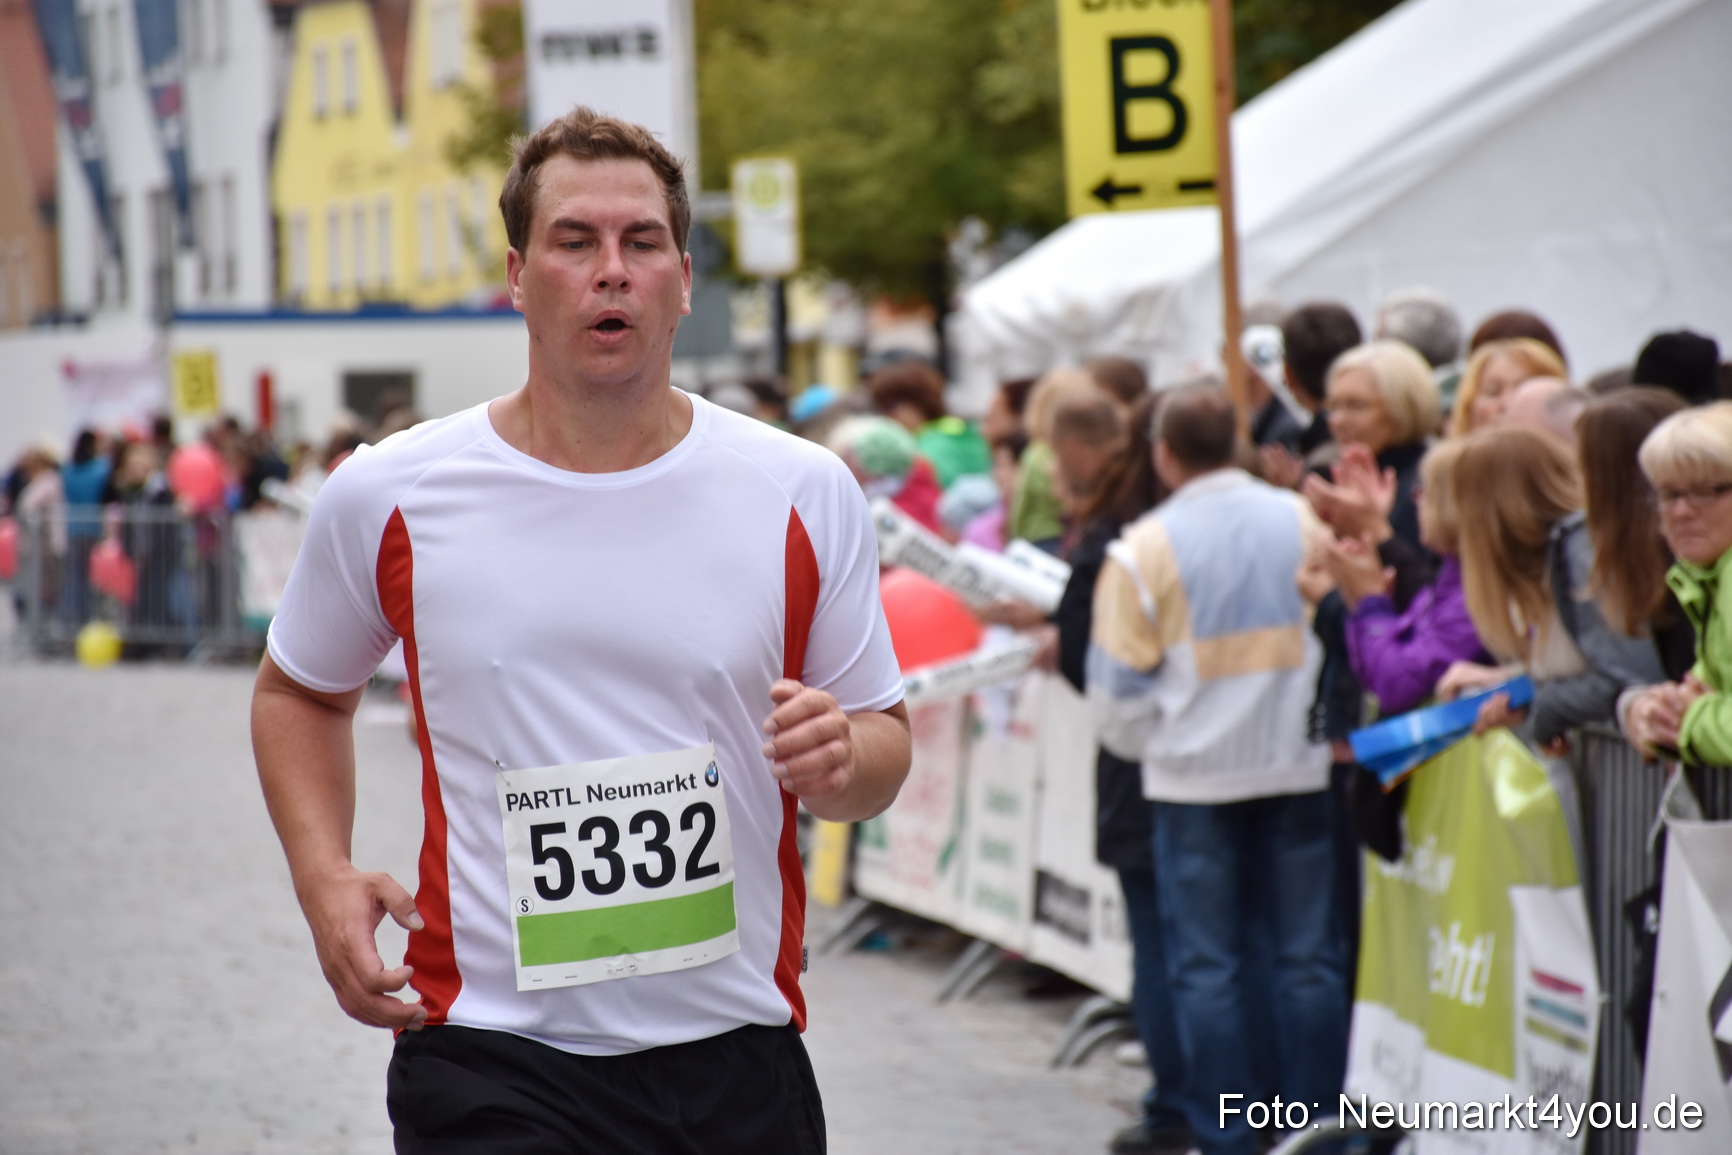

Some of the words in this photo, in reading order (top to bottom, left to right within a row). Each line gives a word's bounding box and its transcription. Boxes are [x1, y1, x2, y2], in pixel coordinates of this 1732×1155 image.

[1109, 34, 1190, 156] B
[505, 787, 581, 812] PARTL
[586, 773, 698, 803] Neumarkt
[529, 801, 721, 902] 5332
[520, 898, 529, 913] S
